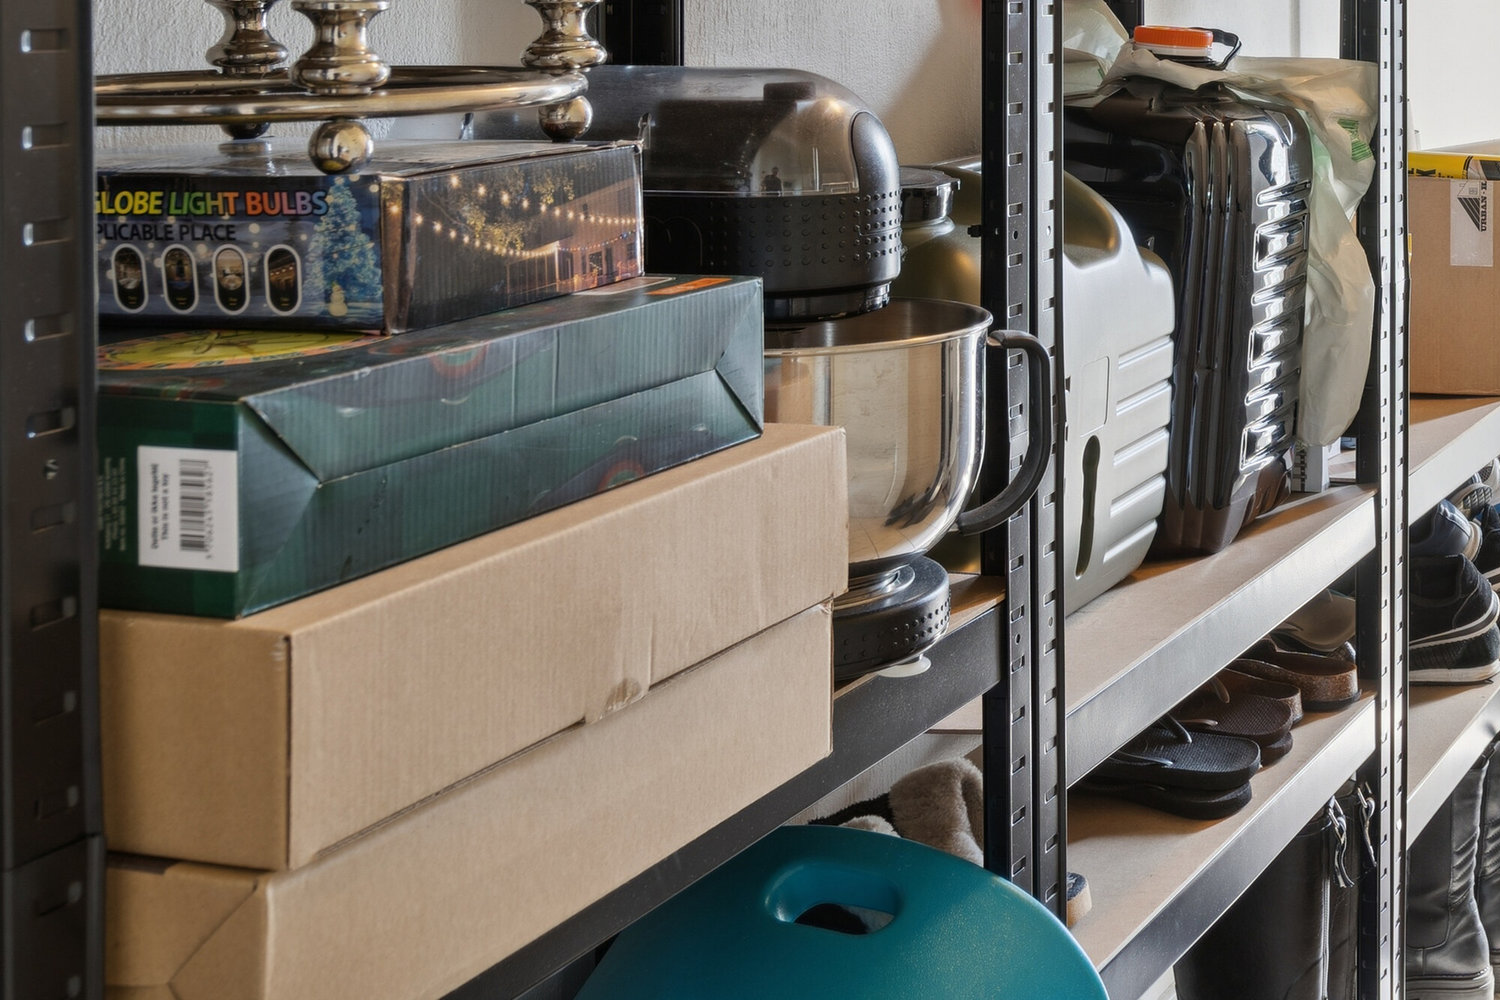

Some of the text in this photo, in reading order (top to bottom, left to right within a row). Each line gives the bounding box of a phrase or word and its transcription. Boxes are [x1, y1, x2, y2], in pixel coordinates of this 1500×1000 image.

[169, 190, 239, 216] LIGHT
[245, 190, 329, 216] BULBS
[180, 223, 236, 241] PLACE
